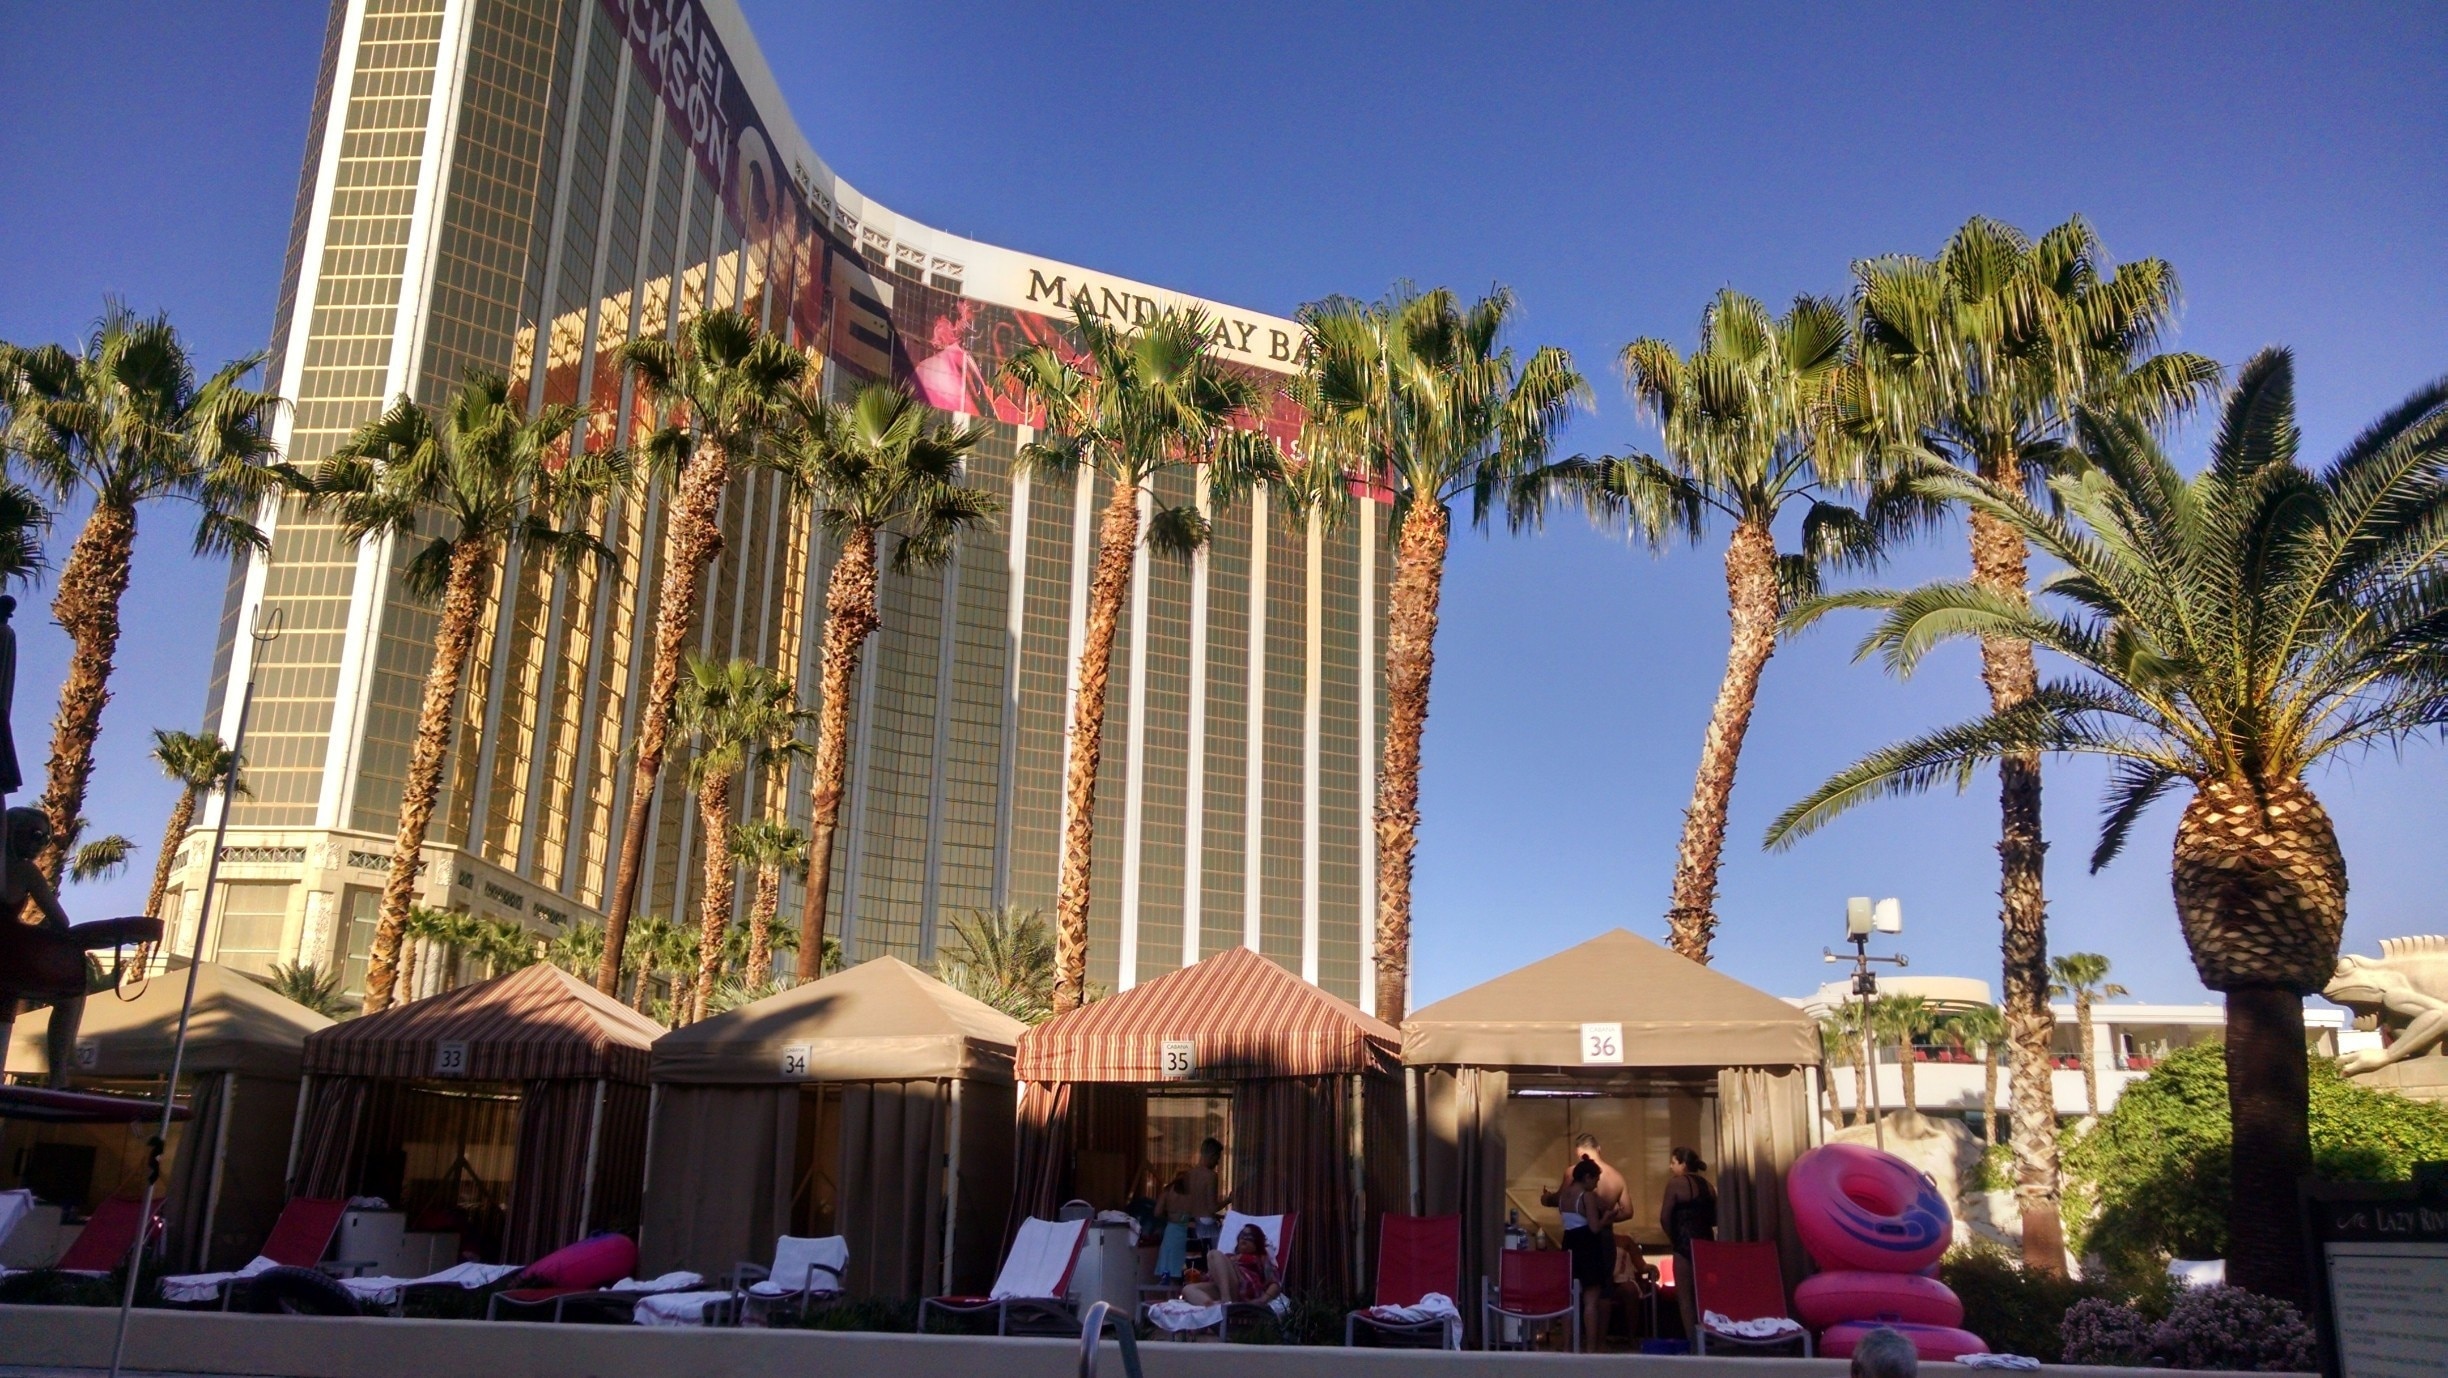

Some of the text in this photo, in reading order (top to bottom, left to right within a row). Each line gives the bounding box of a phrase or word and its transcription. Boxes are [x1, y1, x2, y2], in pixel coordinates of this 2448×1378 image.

[617, 0, 731, 186] CKSON
[1590, 1036, 1616, 1056] 36
[441, 1050, 461, 1068] 33
[786, 1055, 805, 1073] 34
[1167, 1052, 1188, 1070] 35
[2375, 1207, 2414, 1233] LAZY
